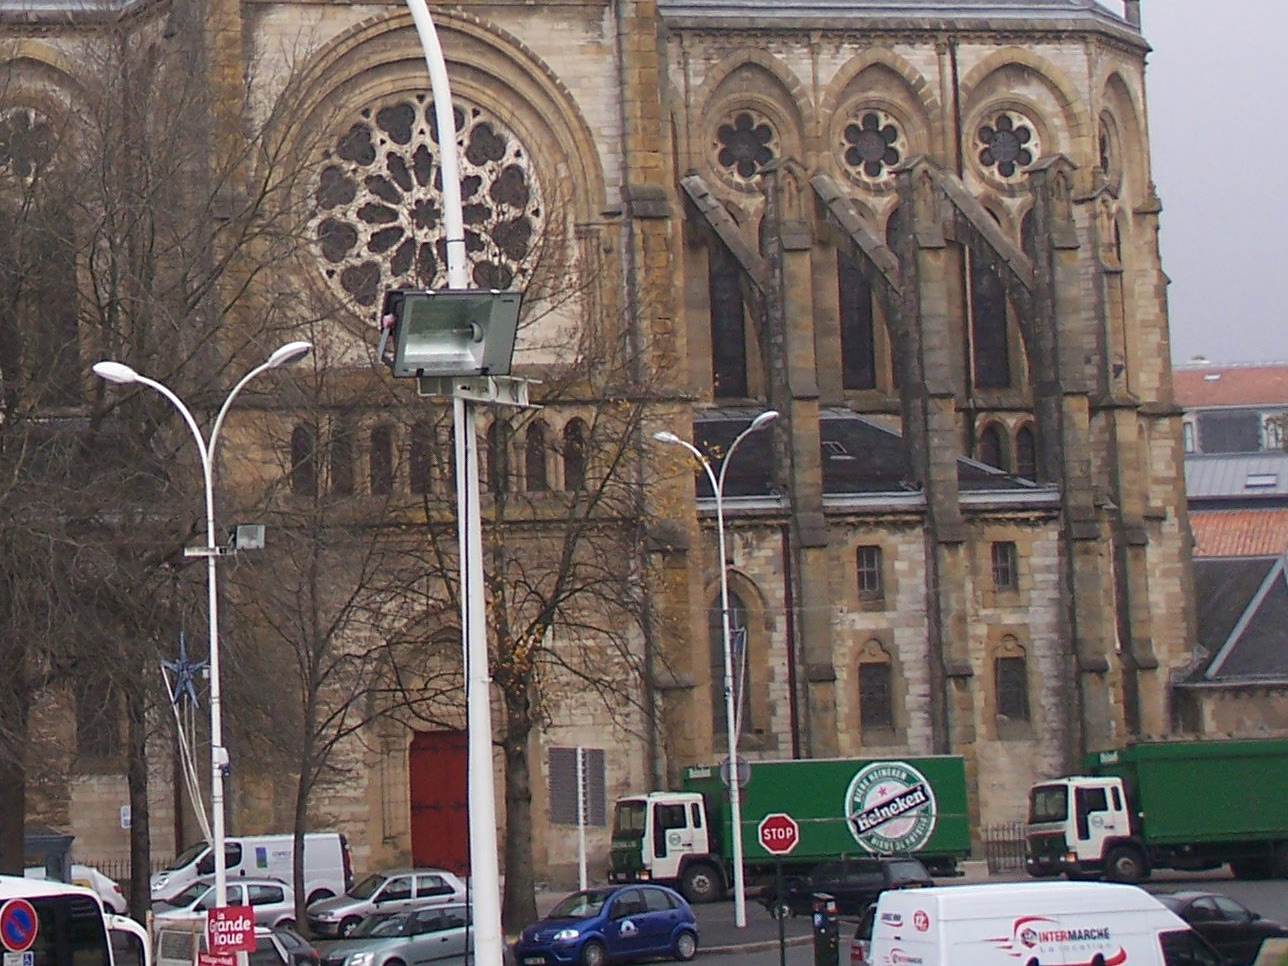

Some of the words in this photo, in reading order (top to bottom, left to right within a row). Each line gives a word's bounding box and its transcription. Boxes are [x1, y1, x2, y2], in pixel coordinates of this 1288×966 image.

[855, 789, 927, 832] Heineken
[763, 827, 793, 840] STOP
[209, 915, 251, 933] Grande
[214, 932, 244, 946] Roue
